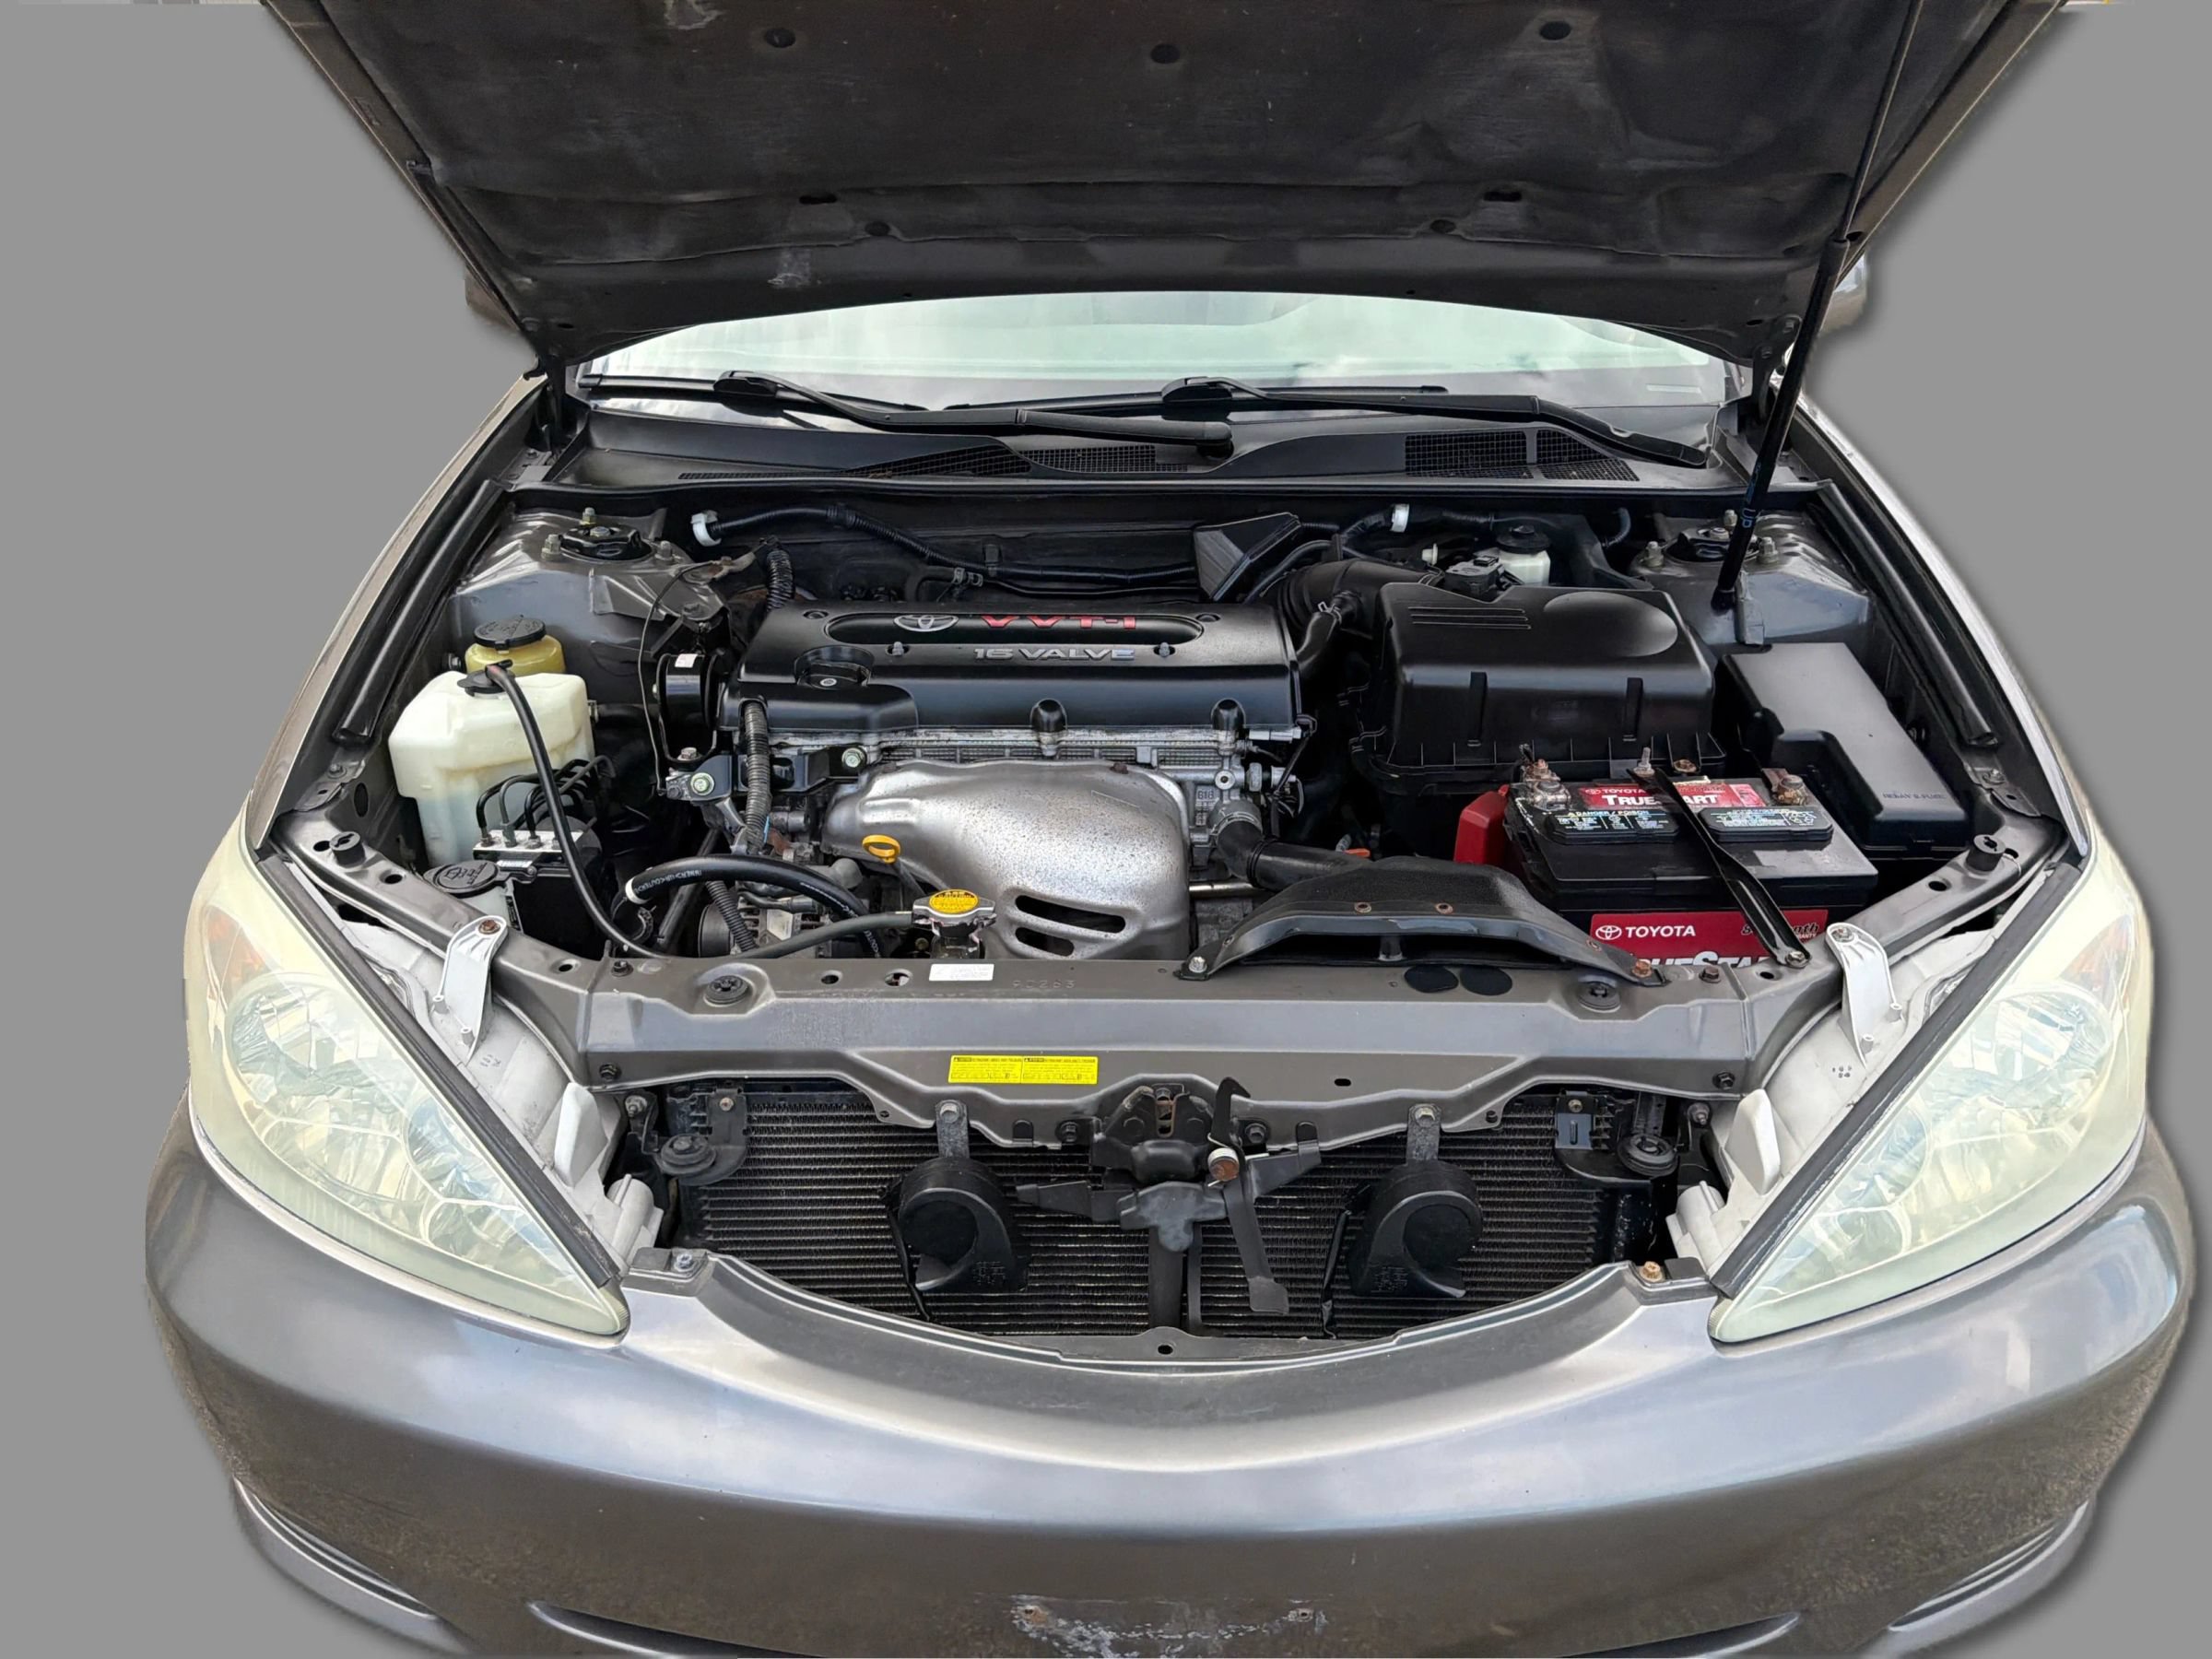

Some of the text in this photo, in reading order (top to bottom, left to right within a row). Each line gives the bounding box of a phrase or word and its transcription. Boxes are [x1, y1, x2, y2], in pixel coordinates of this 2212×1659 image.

[974, 648, 1135, 660] 16 VALVE
[1625, 924, 1696, 938] TOYOTA
